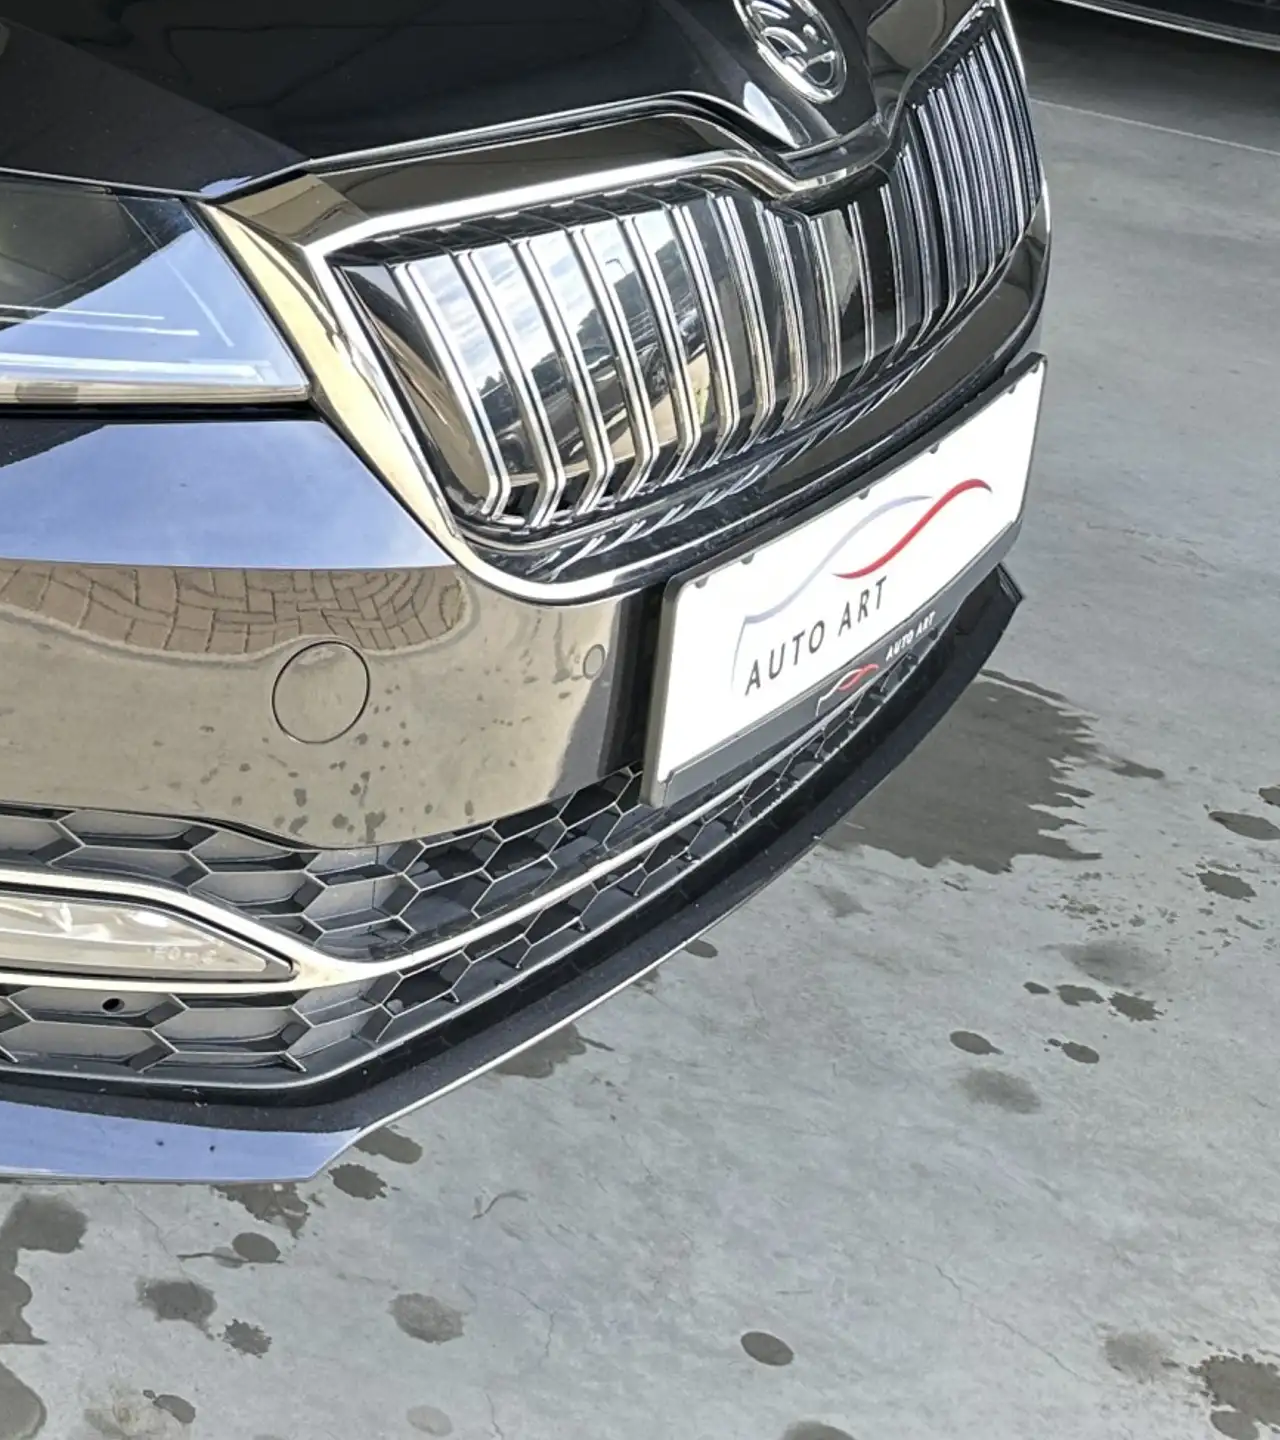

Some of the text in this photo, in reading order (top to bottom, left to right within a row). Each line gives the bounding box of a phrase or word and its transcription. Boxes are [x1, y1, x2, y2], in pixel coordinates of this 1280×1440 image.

[744, 575, 888, 697] AUTO ART
[885, 629, 915, 662] AUTO
